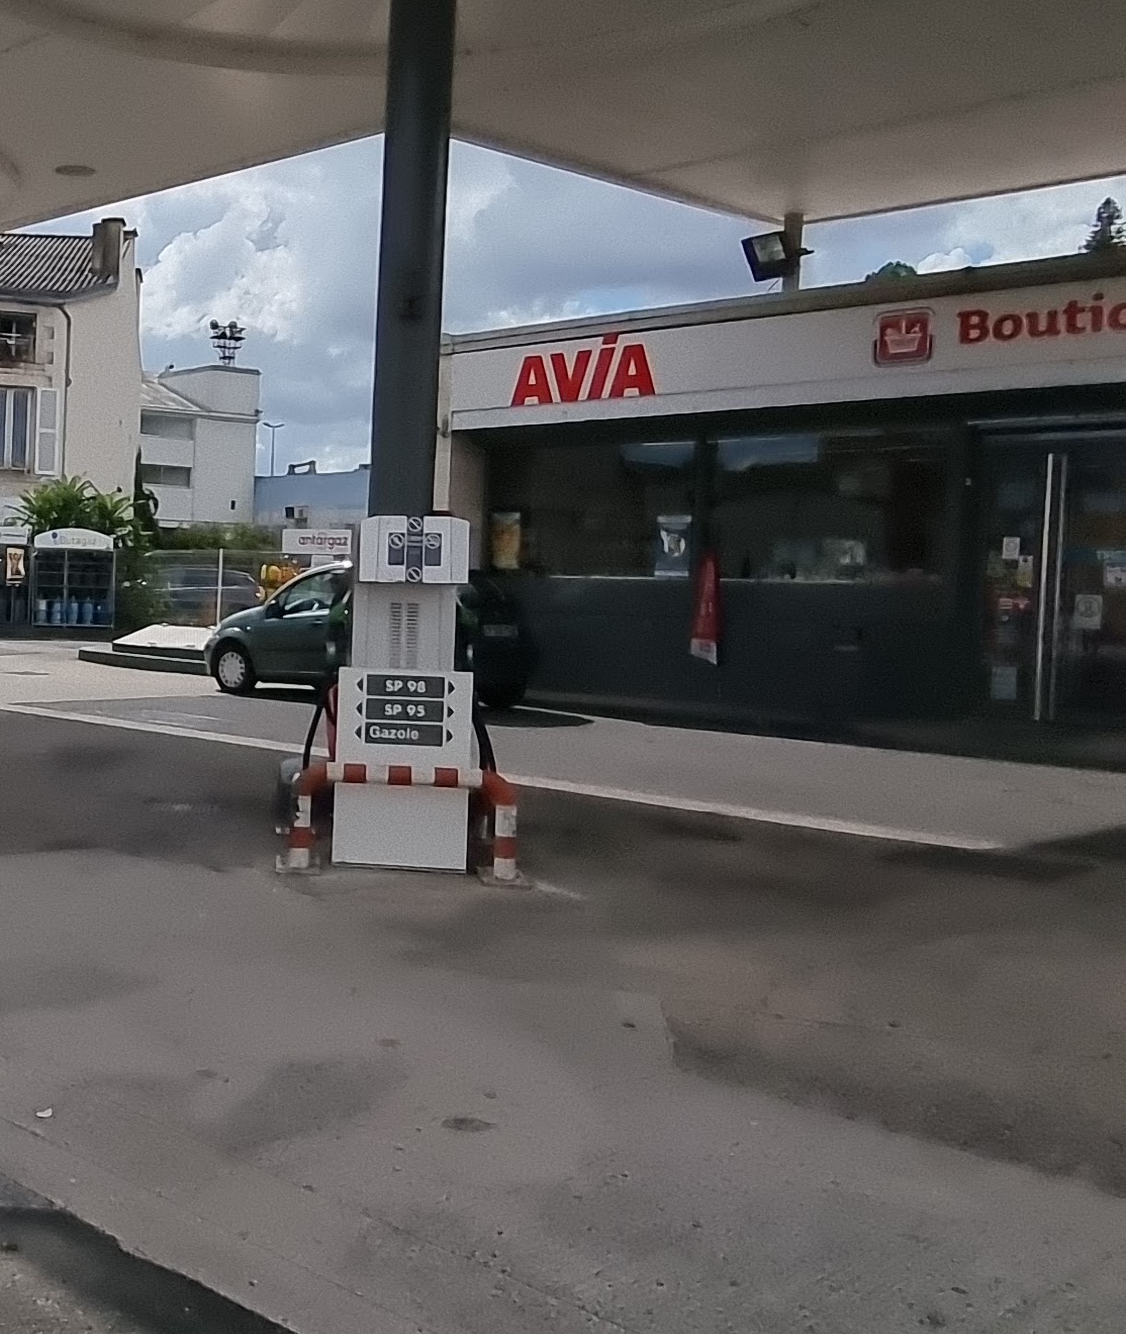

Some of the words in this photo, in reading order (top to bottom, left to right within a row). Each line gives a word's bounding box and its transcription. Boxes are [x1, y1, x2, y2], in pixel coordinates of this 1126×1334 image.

[511, 331, 656, 407] AVIA
[298, 533, 349, 549] antargaz
[385, 679, 403, 692] SP
[407, 680, 426, 693] 98
[384, 703, 402, 716] SP
[406, 704, 426, 716] 95
[369, 725, 419, 740] Gazole
